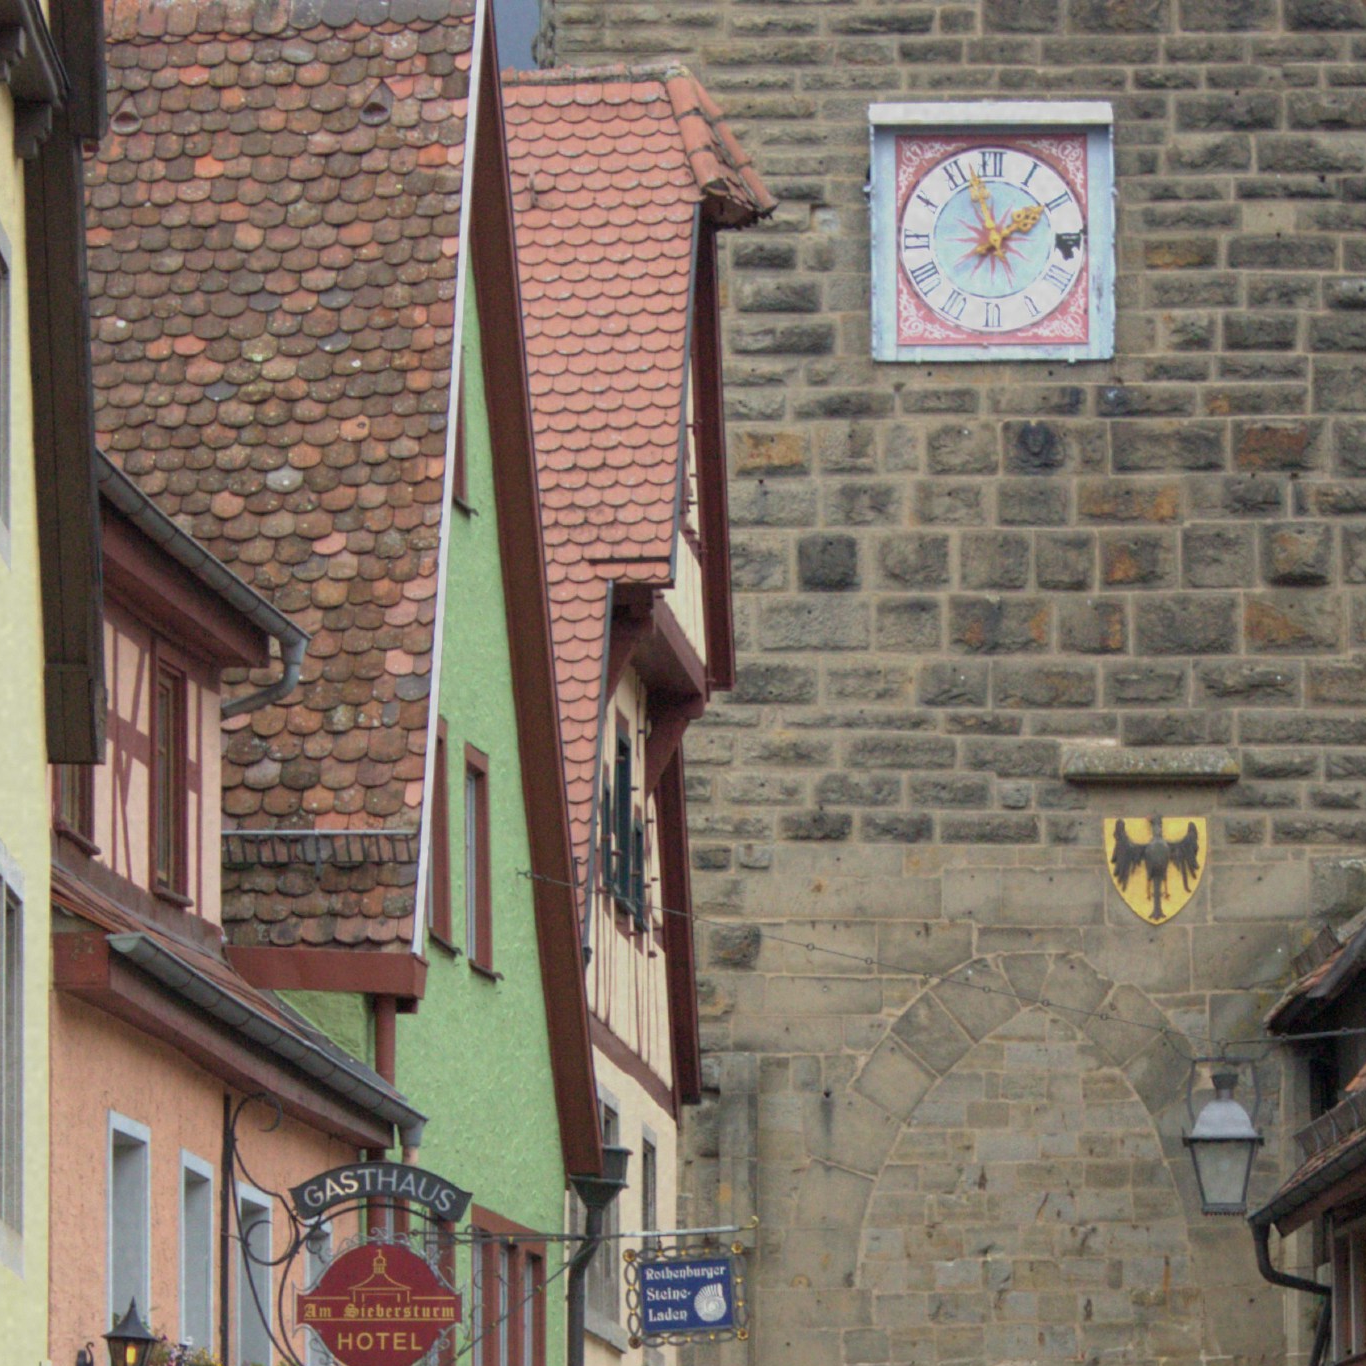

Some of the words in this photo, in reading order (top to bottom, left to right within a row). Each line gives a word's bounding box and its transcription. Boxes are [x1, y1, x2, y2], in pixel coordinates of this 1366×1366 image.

[304, 1168, 456, 1212] GASTHAUS
[645, 1265, 726, 1280] Rothenburger
[304, 1303, 332, 1319] Am
[344, 1302, 455, 1319] Siebersturm
[648, 1307, 688, 1322] Laden
[337, 1332, 423, 1351] HOTEL
